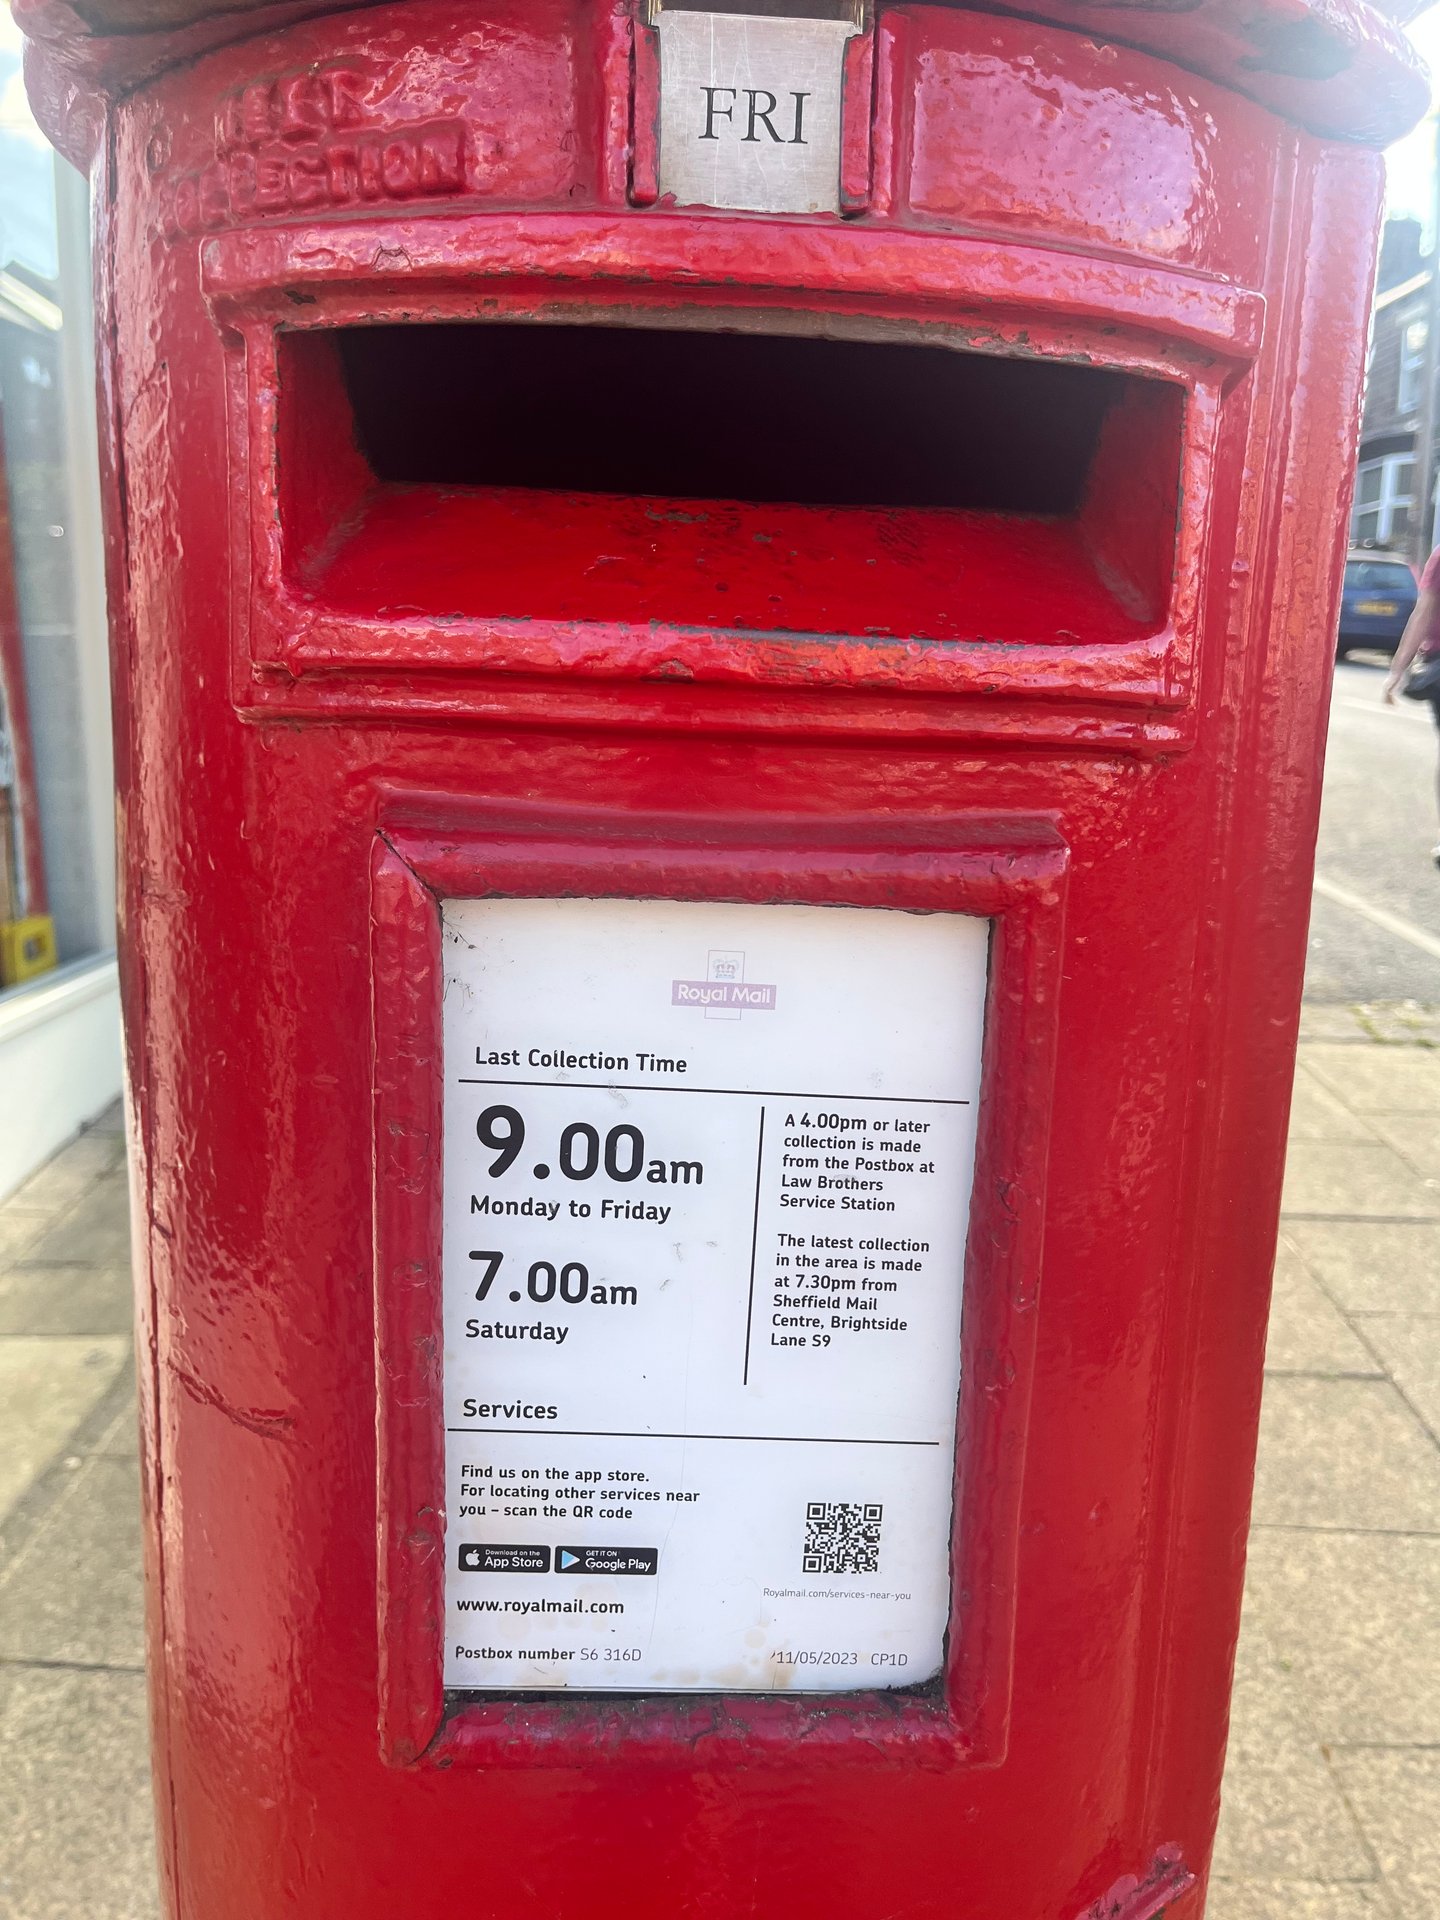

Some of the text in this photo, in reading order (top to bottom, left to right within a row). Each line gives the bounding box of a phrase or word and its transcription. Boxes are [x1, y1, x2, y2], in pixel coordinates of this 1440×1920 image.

[698, 87, 811, 144] FRI
[678, 984, 771, 1004] Royal Mail
[476, 1046, 687, 1073] Last Collection Time
[785, 1112, 930, 1133] A 4.00pm or later
[476, 1105, 703, 1184] 9.00am
[784, 1135, 921, 1153] collection is made
[783, 1154, 935, 1173] from the Postbox at
[782, 1174, 883, 1191] Law Brothers
[471, 1195, 671, 1225] Monday to Friday
[780, 1194, 895, 1211] Service Station
[777, 1233, 929, 1252] The latest collection
[776, 1253, 922, 1271] in the area is made
[469, 1251, 637, 1306] 7.00am
[774, 1274, 897, 1292] at 7.30pm from
[773, 1294, 877, 1310] Sheffield Mail
[466, 1319, 569, 1344] Saturday
[772, 1313, 907, 1332] Centre, Brightside
[771, 1333, 831, 1347] Lane S9
[463, 1399, 557, 1419] Services
[462, 1465, 649, 1483] Find us on the app store.
[461, 1484, 700, 1502] For locating other services near
[460, 1505, 486, 1517] you
[504, 1507, 537, 1517] scan
[543, 1504, 567, 1517] the
[573, 1505, 593, 1519] QR
[599, 1506, 632, 1519] code
[484, 1556, 544, 1568] App Store
[585, 1558, 651, 1572] Google Play
[763, 1587, 912, 1601] Royalmail.com/services-near-you
[457, 1598, 625, 1615] www.royalmail.com
[456, 1646, 641, 1661] Postbox number S6 316D
[871, 1653, 908, 1665] CP1D
